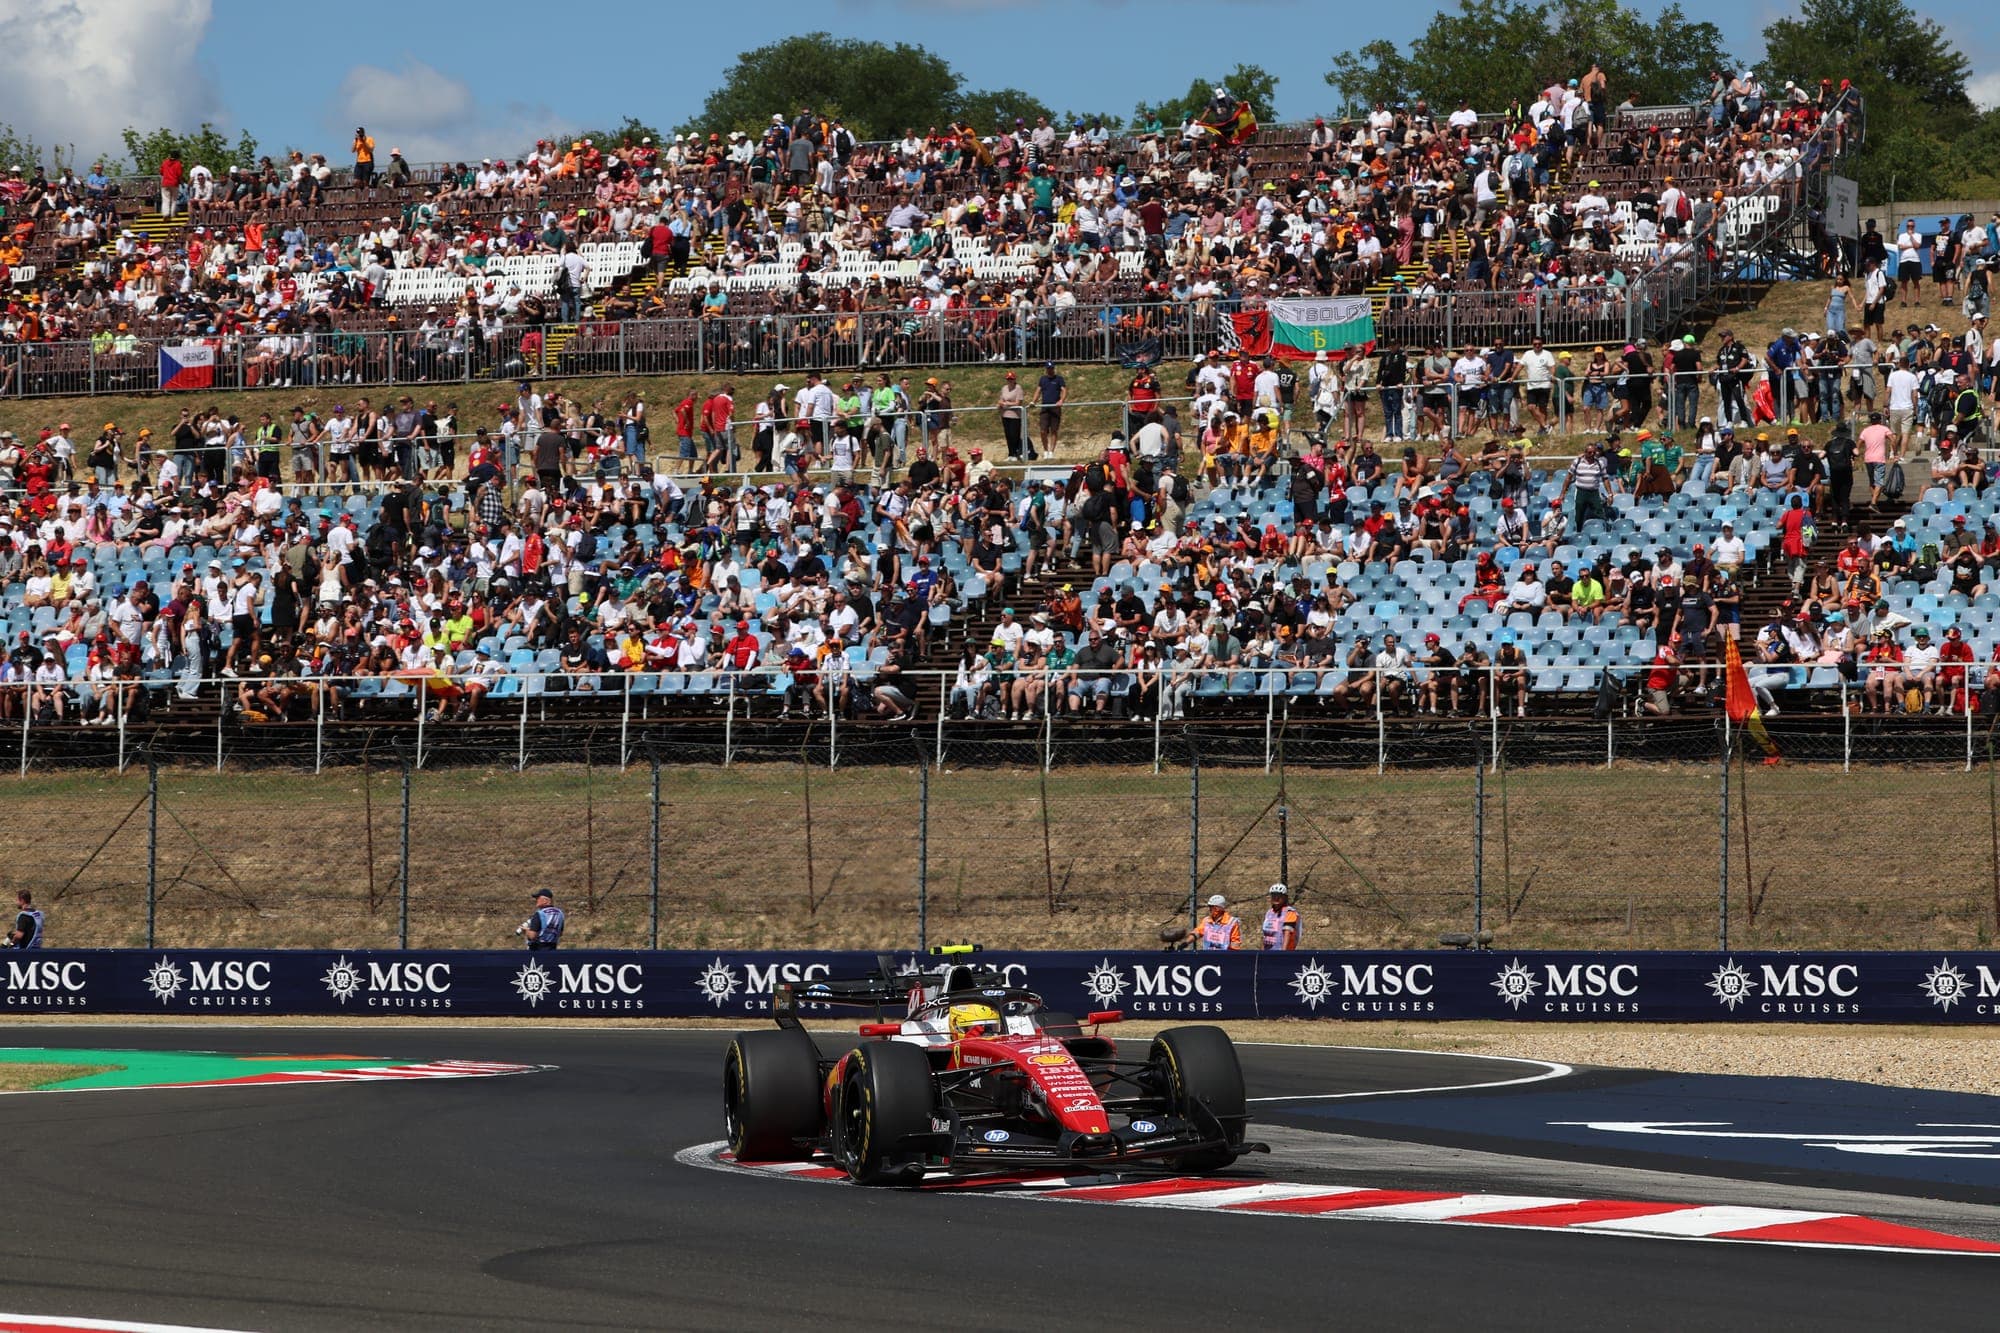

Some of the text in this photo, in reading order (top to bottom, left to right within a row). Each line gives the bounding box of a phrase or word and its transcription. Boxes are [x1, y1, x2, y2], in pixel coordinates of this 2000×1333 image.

[1280, 373, 1293, 385] 87
[8, 961, 86, 991] MSC
[190, 961, 271, 991] MSC
[368, 962, 451, 993] MSC
[558, 963, 643, 994] MSC
[1133, 964, 1222, 997] MSC
[1341, 964, 1434, 996] MSC
[1544, 964, 1638, 997] MSC
[1761, 964, 1859, 997] MSC
[8, 996, 86, 1006] CRUISES
[190, 996, 271, 1006] CRUISES
[368, 997, 451, 1008] CRUISES
[559, 999, 643, 1009] CRUISES
[1134, 1002, 1223, 1012] CRUISES
[1342, 1001, 1434, 1012] CRUISES
[1545, 1002, 1639, 1013] CRUISES
[1761, 1003, 1860, 1013] CRUISES
[1018, 1045, 1063, 1055] 44
[1037, 1066, 1083, 1075] IBM
[1135, 1120, 1154, 1133] hp
[987, 1129, 1007, 1142] hp
